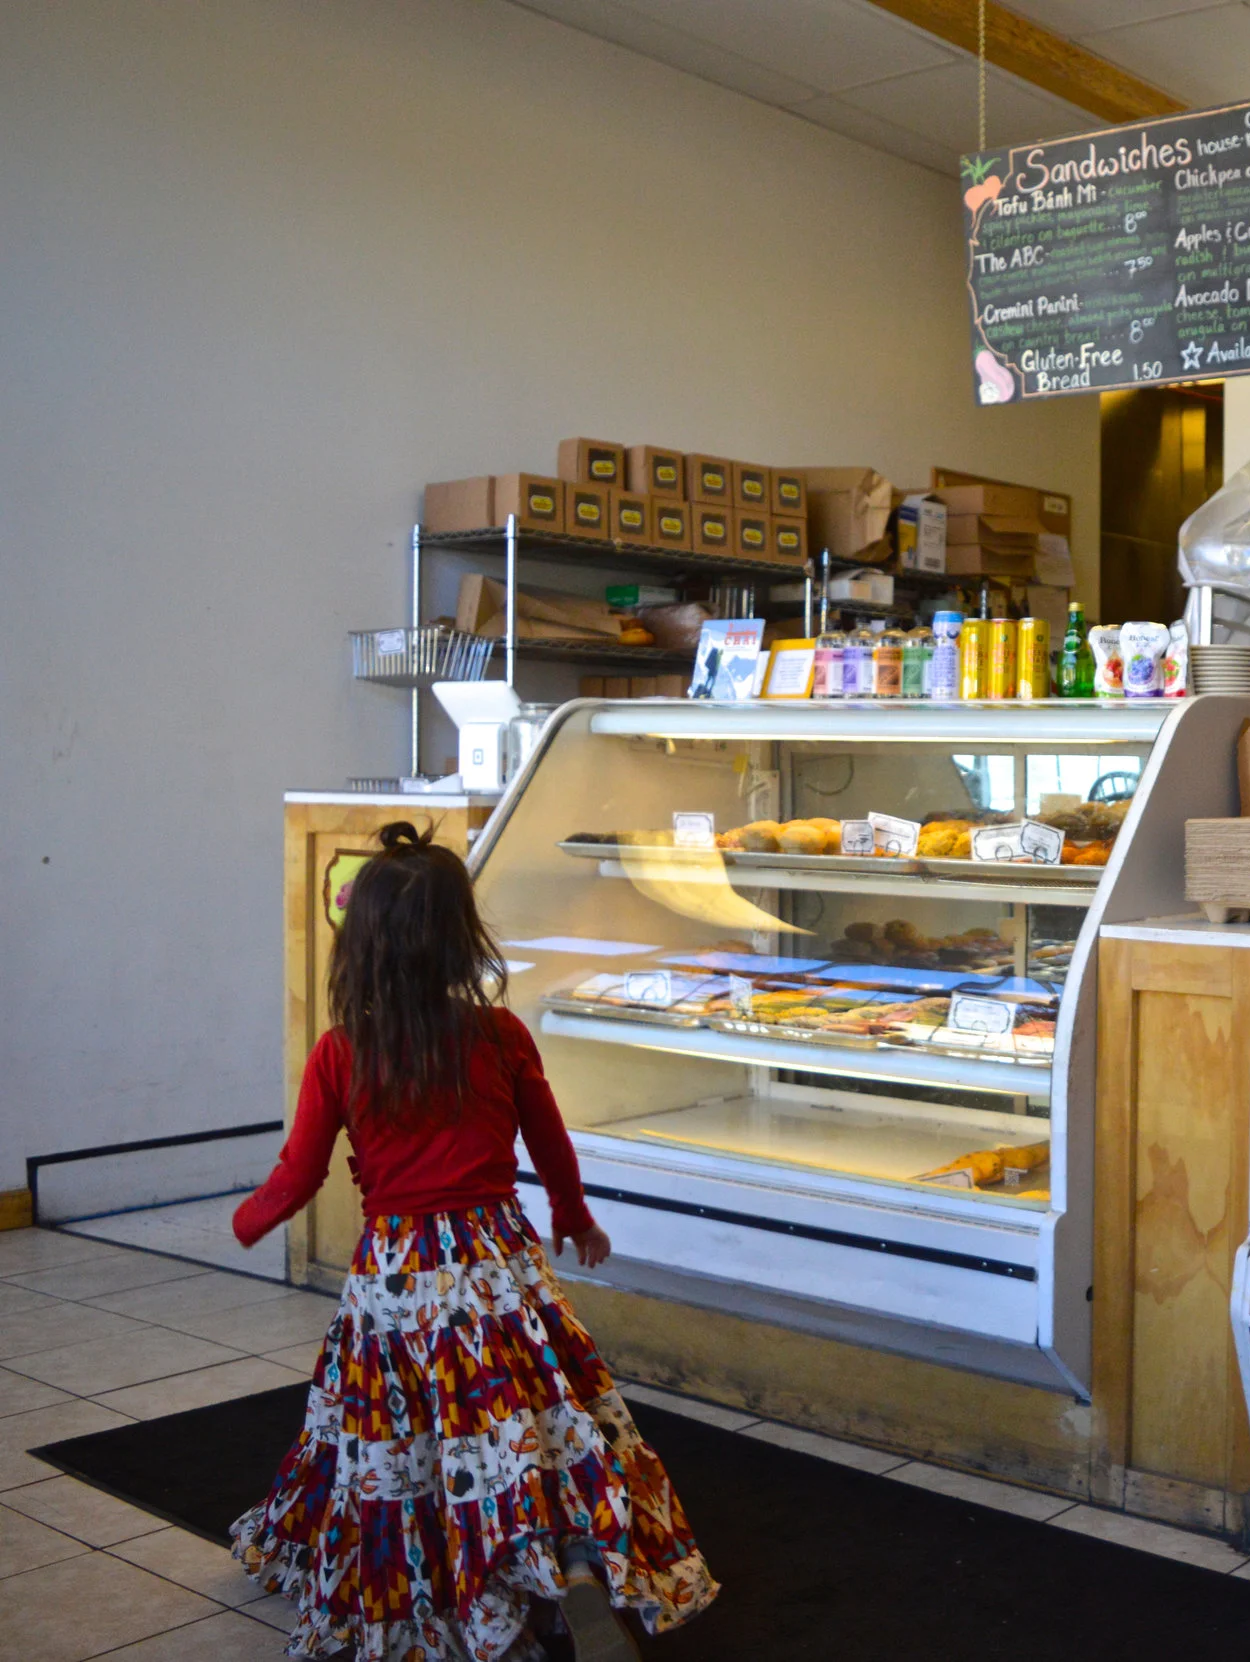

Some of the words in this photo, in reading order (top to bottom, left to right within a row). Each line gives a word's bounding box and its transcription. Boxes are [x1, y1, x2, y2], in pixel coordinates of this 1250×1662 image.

[1016, 132, 1192, 193] Sandwiches
[1175, 163, 1241, 191] Chickpea
[993, 195, 1027, 217] Tofu
[1174, 224, 1221, 250] Apples
[975, 252, 1007, 273] The
[1175, 248, 1213, 266] radish
[1174, 280, 1239, 307] Avocado
[983, 299, 1034, 325] Cremini
[1037, 364, 1091, 392] Bread
[1133, 361, 1163, 381] 1.50
[724, 635, 757, 646] CHAI
